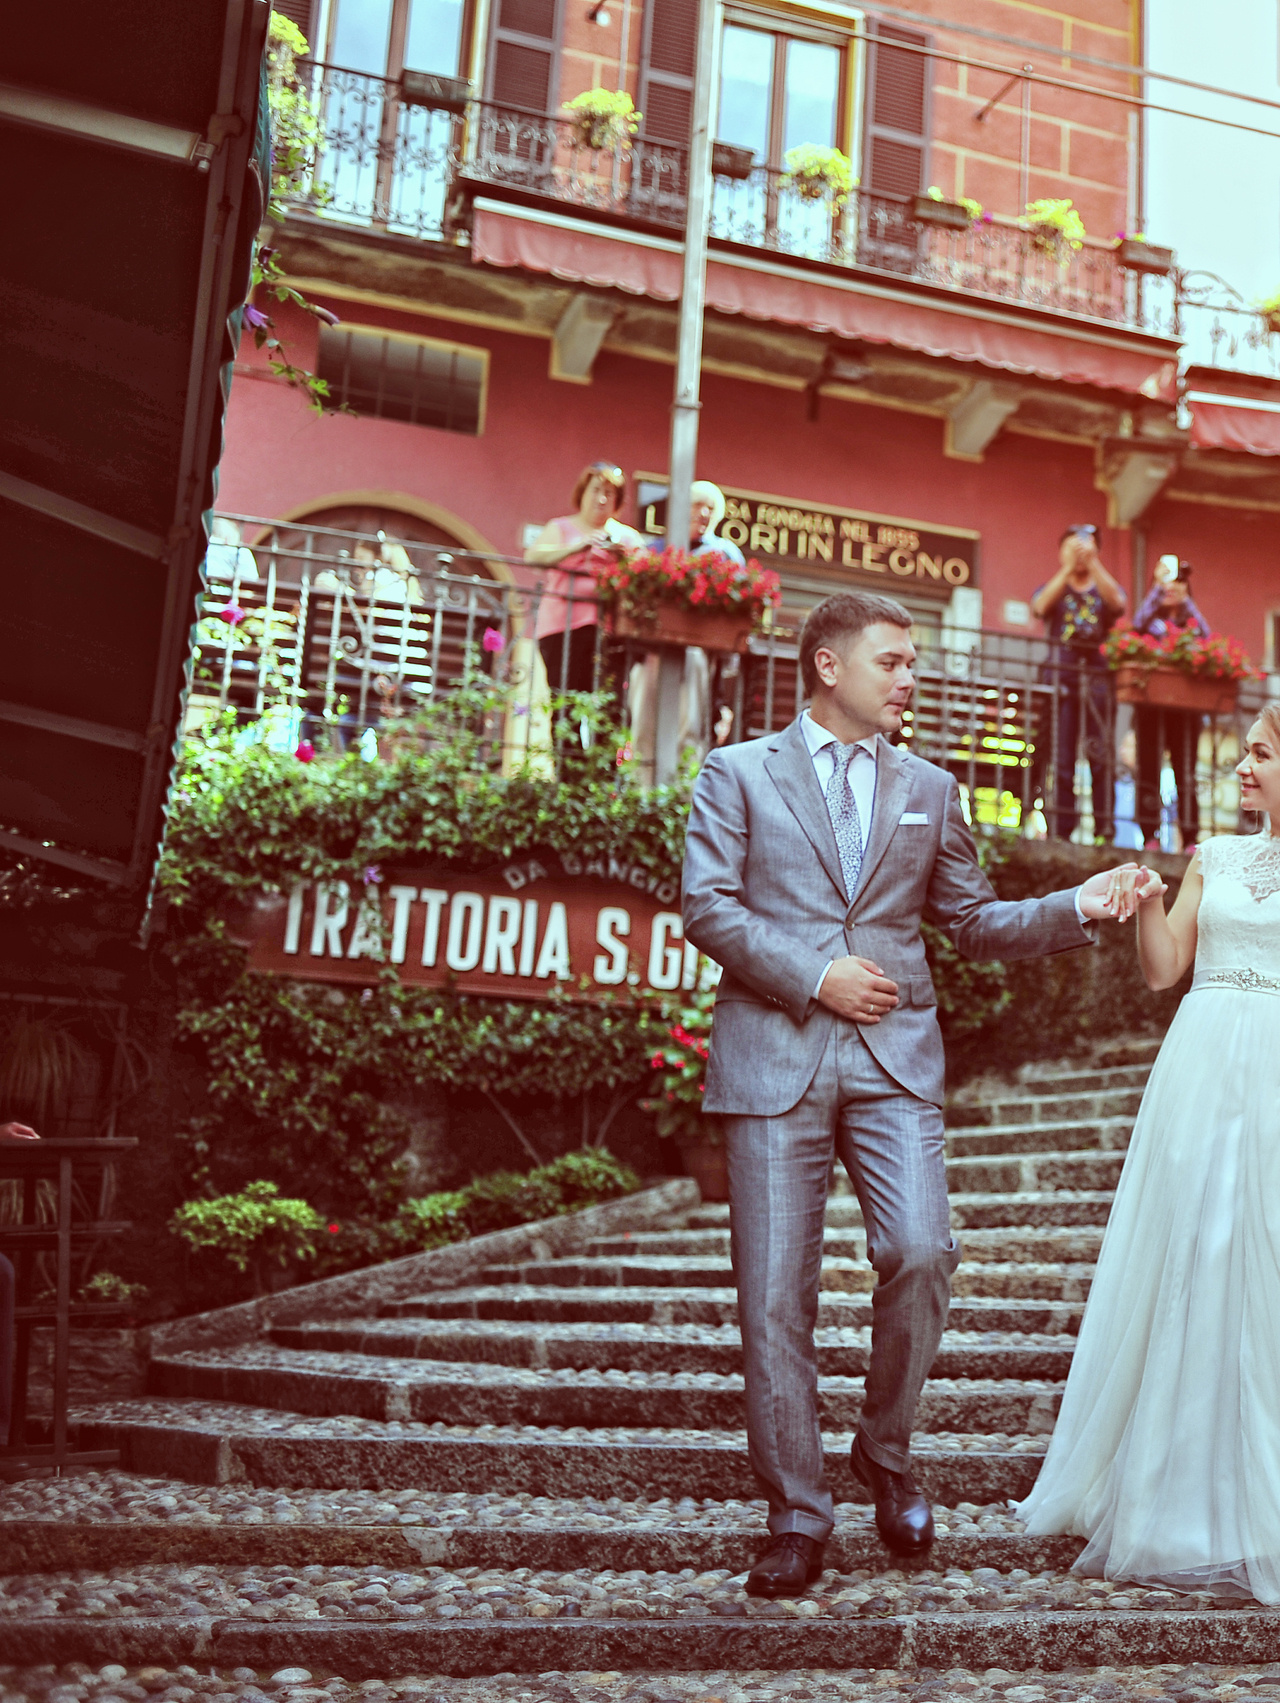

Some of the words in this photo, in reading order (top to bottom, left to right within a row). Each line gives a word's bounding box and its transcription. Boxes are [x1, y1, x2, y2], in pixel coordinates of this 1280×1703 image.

[798, 530, 834, 562] IN
[842, 539, 969, 585] LEGNO
[284, 877, 570, 981] TRATTORIA
